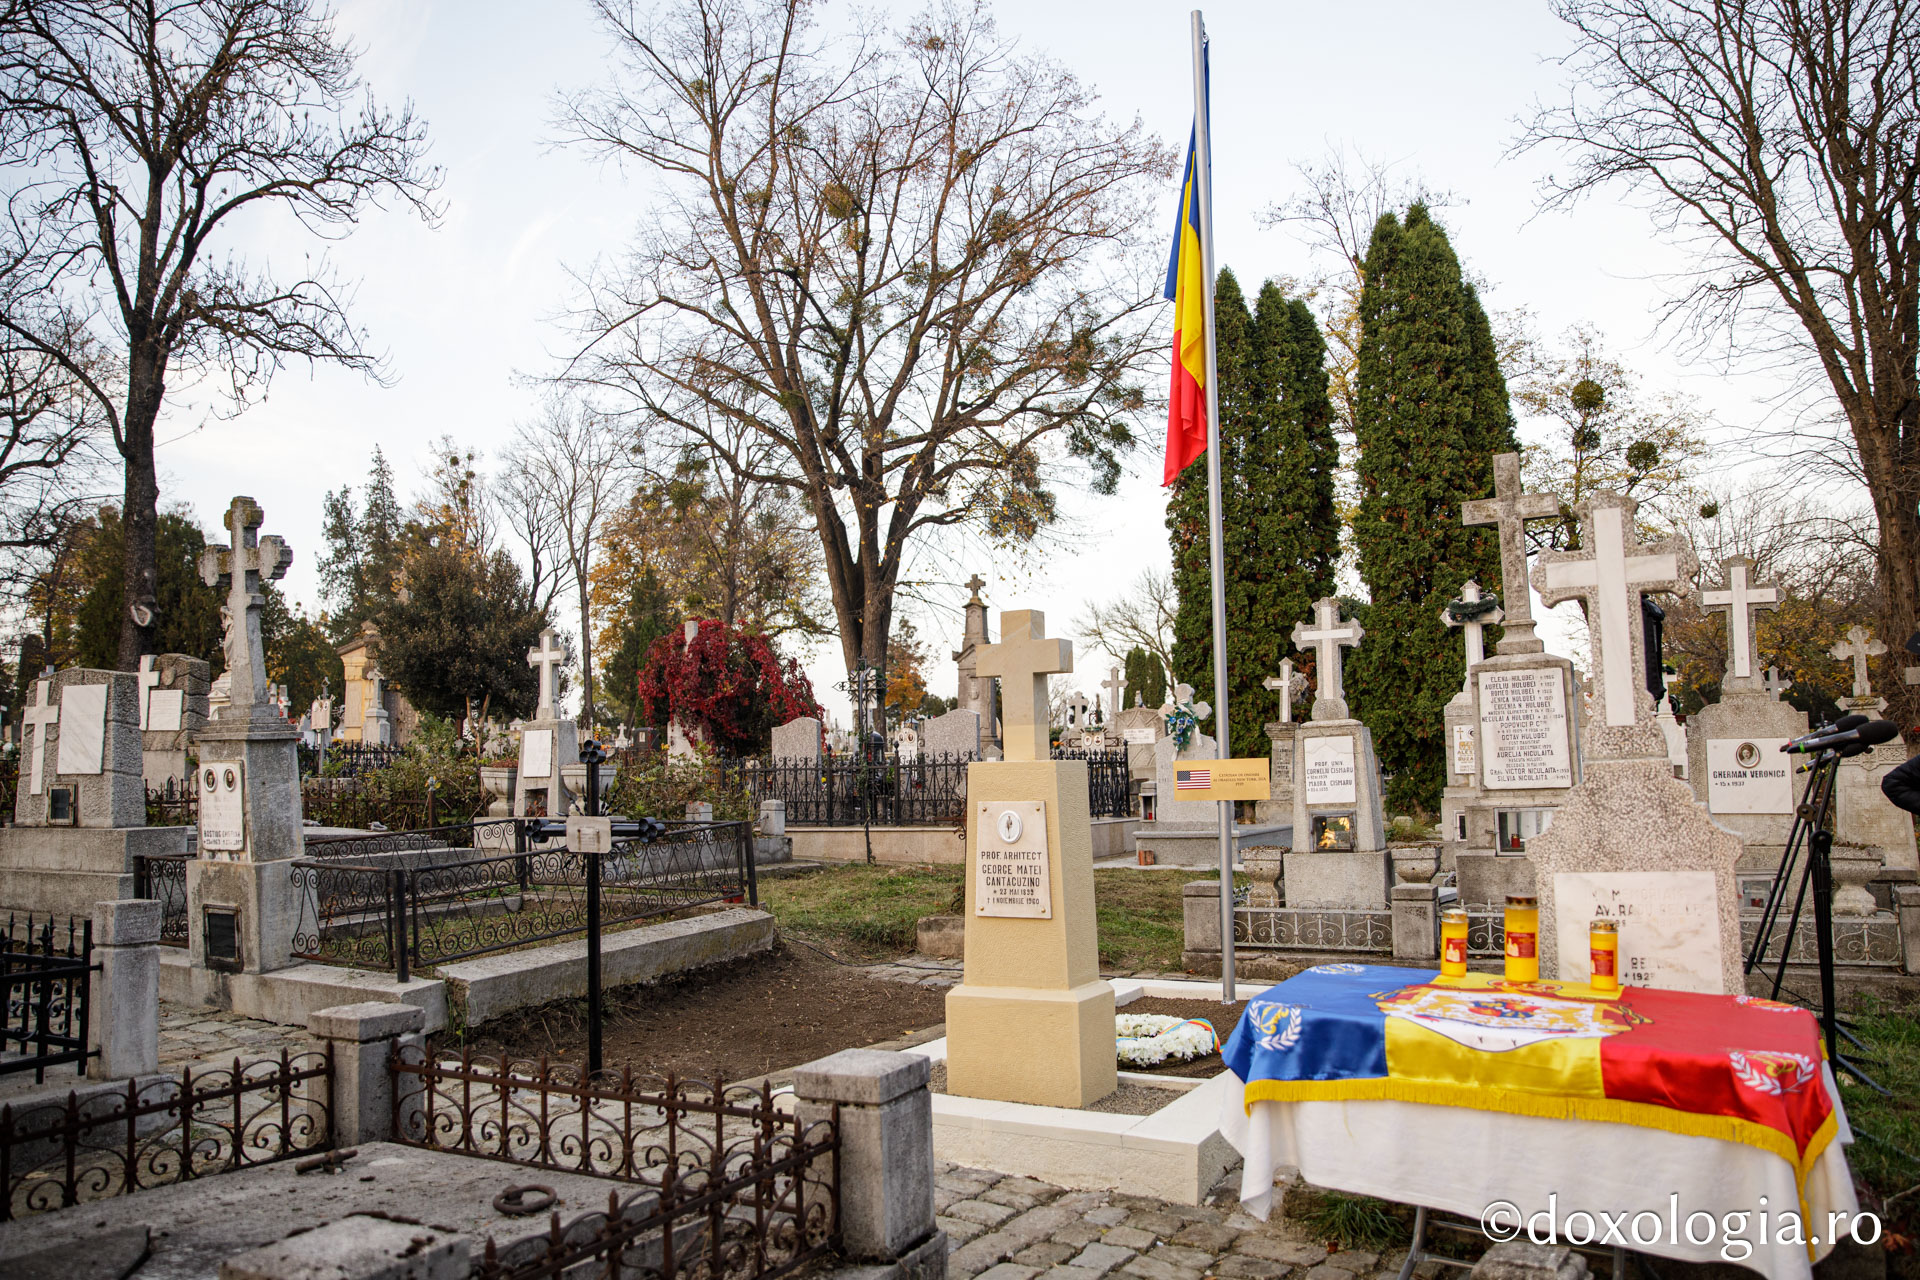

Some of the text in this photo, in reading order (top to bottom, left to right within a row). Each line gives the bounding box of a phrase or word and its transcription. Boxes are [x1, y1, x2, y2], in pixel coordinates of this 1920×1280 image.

[1526, 701, 1551, 709] HULUBEI
[1482, 715, 1504, 723] NECULAI
[1521, 732, 1548, 740] HULUBEI
[1505, 767, 1526, 775] VICTOR
[1713, 770, 1786, 779] GHERMAN VERONICA
[1330, 779, 1353, 787] CISMARU
[981, 851, 1042, 860] PROF. ARHITECT
[982, 864, 1042, 876] GEORGE MATEI
[986, 877, 1040, 887] CANTACUZINO
